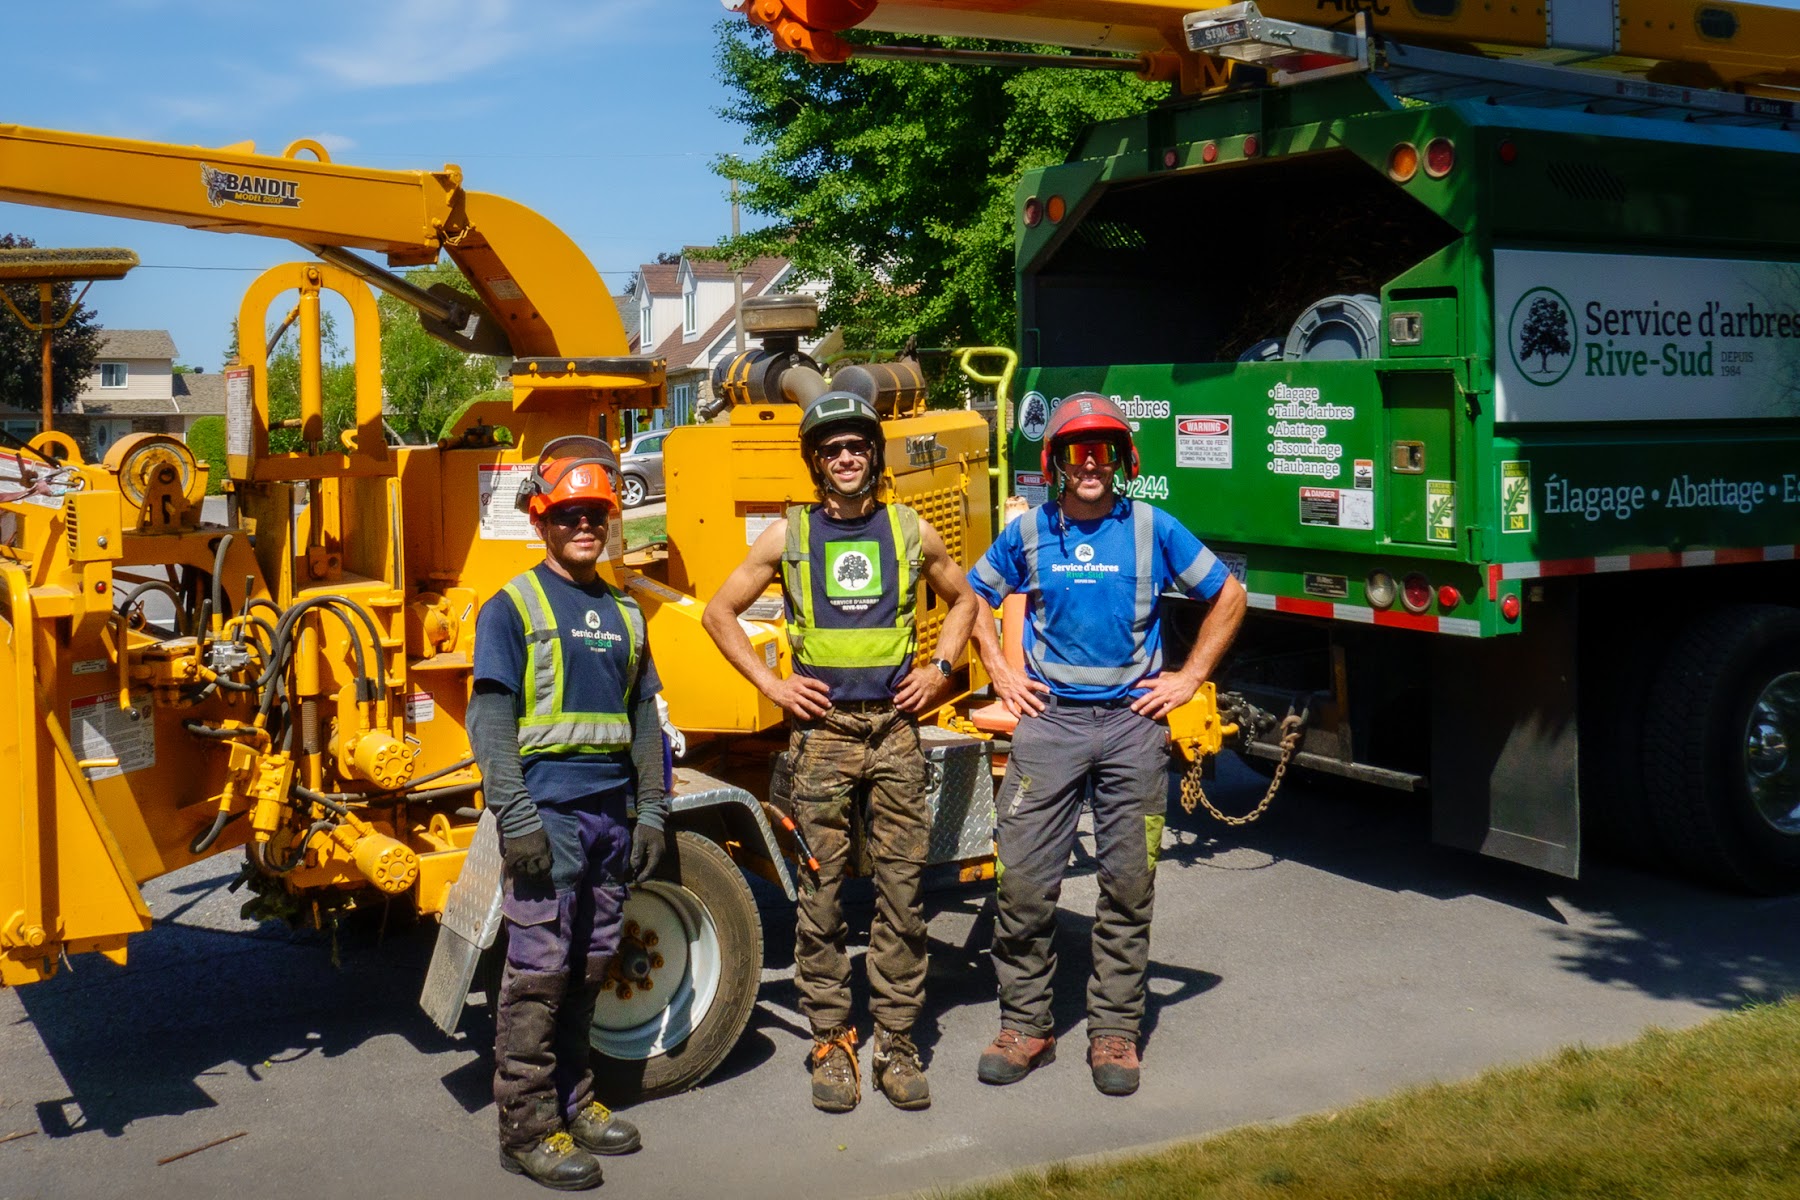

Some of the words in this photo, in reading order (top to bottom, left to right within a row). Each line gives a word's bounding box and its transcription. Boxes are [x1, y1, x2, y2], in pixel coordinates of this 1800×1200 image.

[226, 173, 299, 198] BANDIT
[234, 192, 261, 203] MODEL
[1585, 301, 1692, 337] Service
[1699, 301, 1800, 339] d'arbres
[1584, 339, 1715, 377] Rive-Sud
[1721, 352, 1754, 363] DEPUIS
[1721, 365, 1742, 377] 1984
[1275, 382, 1318, 402] Élagage
[1275, 404, 1305, 418] Taille
[1306, 403, 1354, 419] d'arbres
[1186, 422, 1221, 432] WARNING
[1274, 422, 1326, 440] Abattage
[1274, 441, 1342, 460] Essouchage
[1274, 459, 1339, 478] Haubanage
[1544, 473, 1645, 521] Élagage
[1665, 474, 1764, 513] Abattage
[1051, 563, 1083, 572] Service
[1084, 562, 1119, 572] d'arbres
